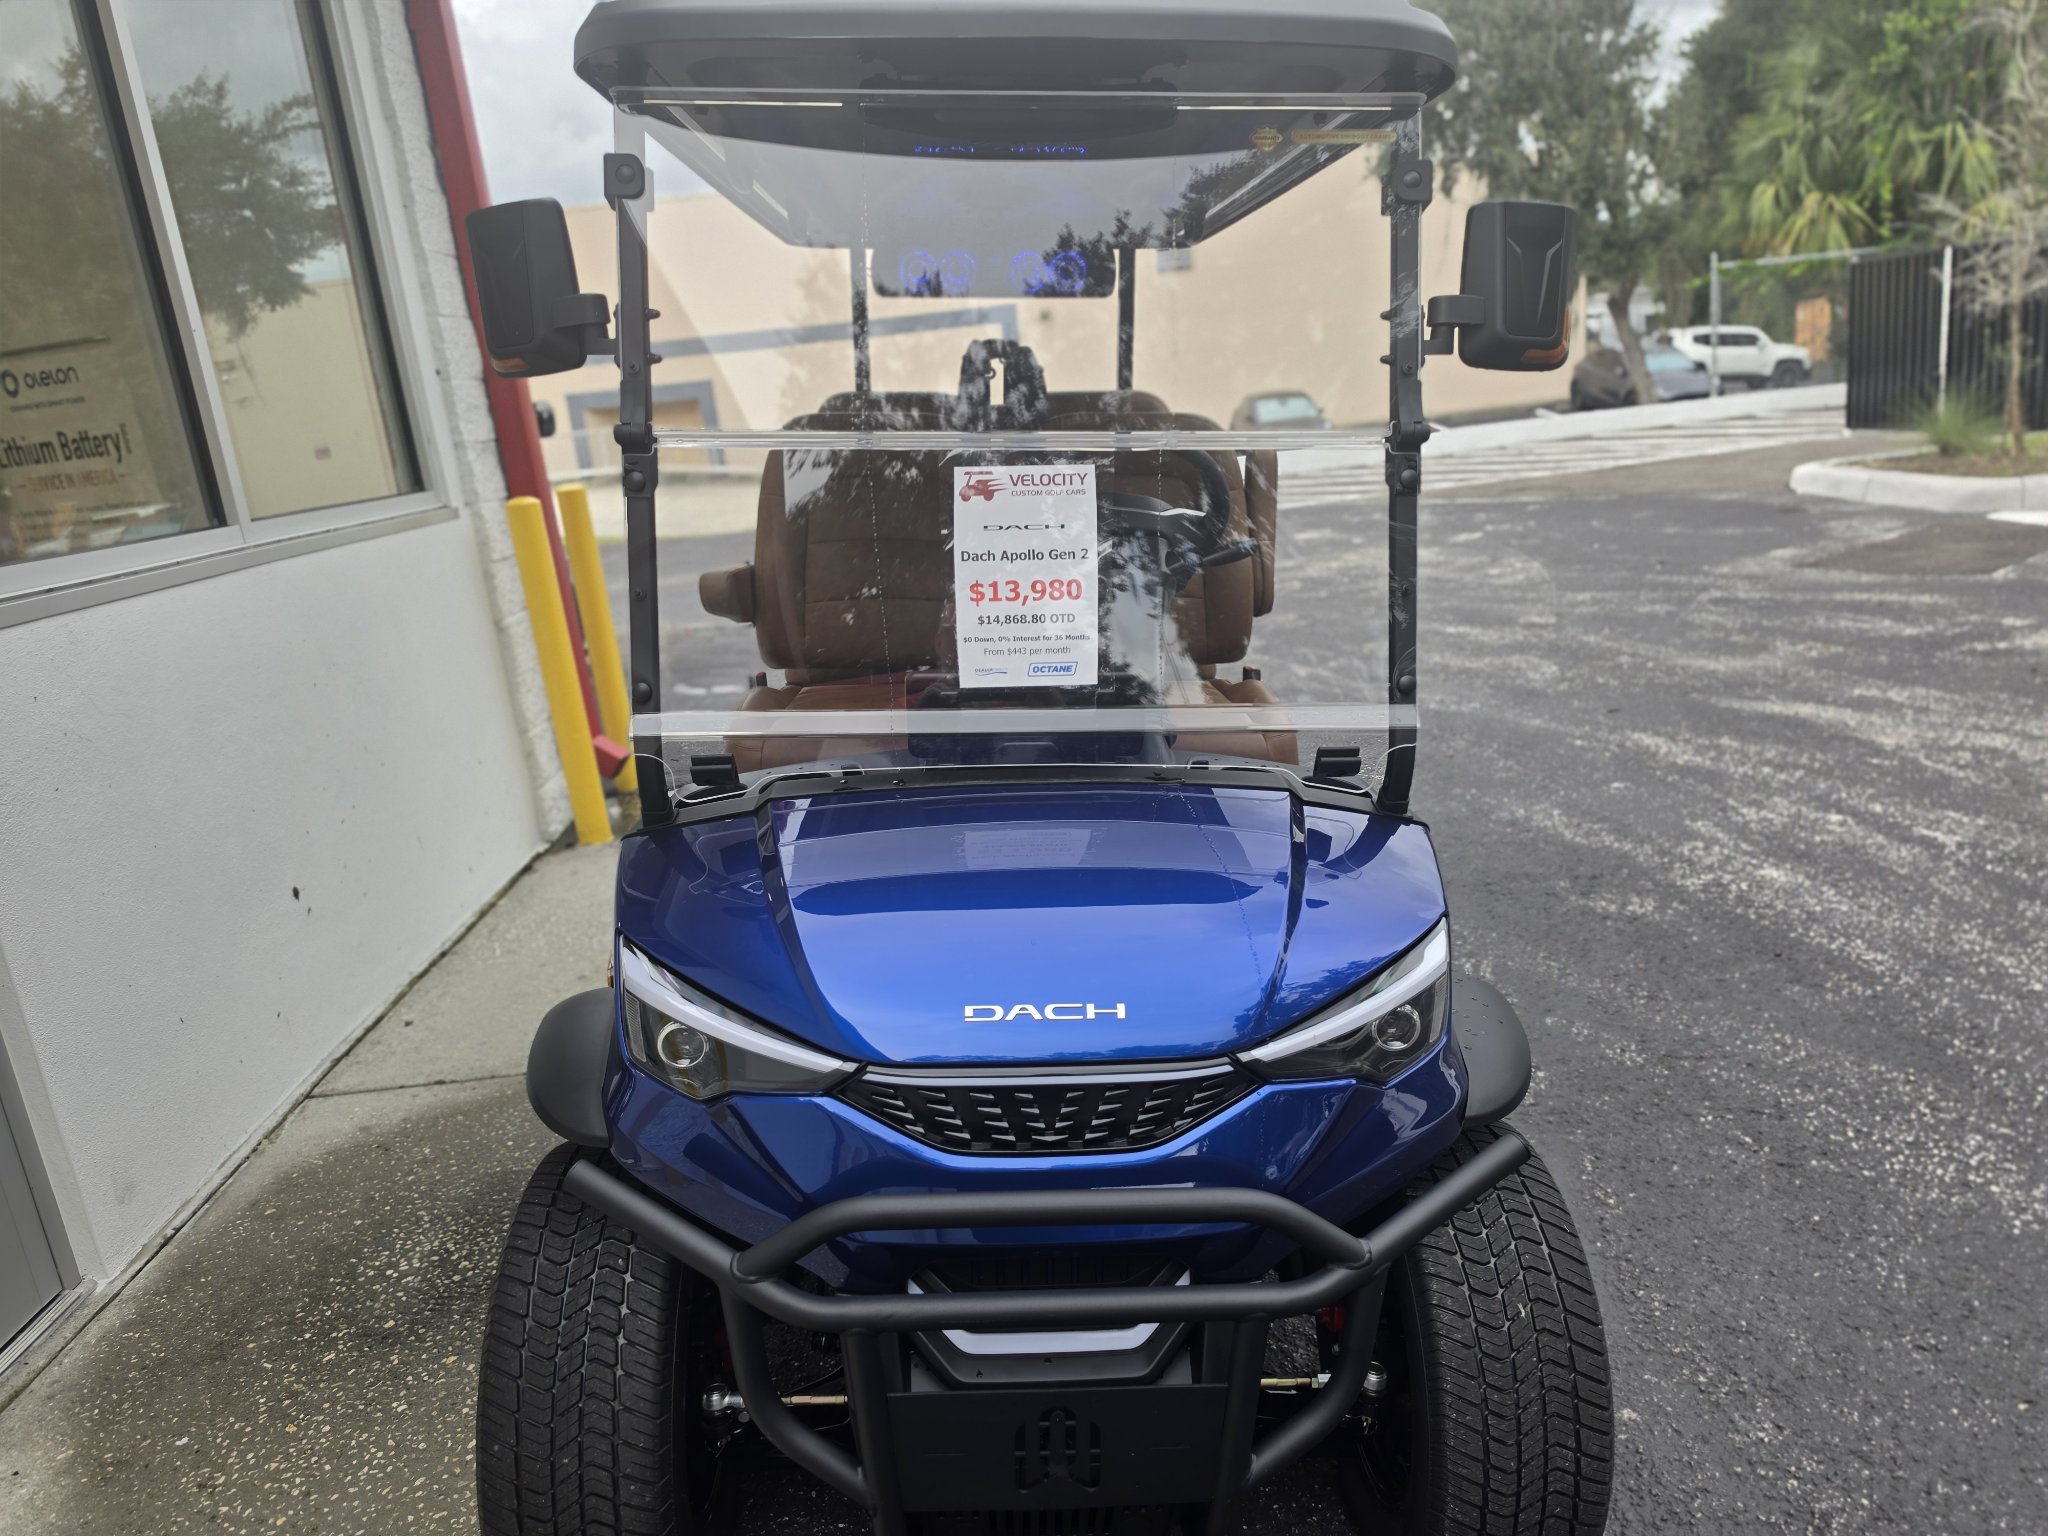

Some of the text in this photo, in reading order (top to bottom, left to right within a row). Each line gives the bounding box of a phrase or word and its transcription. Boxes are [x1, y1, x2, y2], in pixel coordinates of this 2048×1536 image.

[56, 429, 122, 464] Battery
[1009, 472, 1088, 487] VELOCITY
[1065, 488, 1087, 496] CARS
[983, 523, 1065, 532] DACH
[960, 548, 1089, 564] Dach Apollo Gen 2
[969, 578, 1083, 607] $13,980
[977, 613, 1076, 627] $14,868.80 OTD
[963, 636, 973, 644] $0
[974, 636, 997, 644] Down,
[983, 646, 1071, 656] From $443 per month
[1032, 665, 1074, 674] OCTANE
[964, 1002, 1126, 1022] DACH
